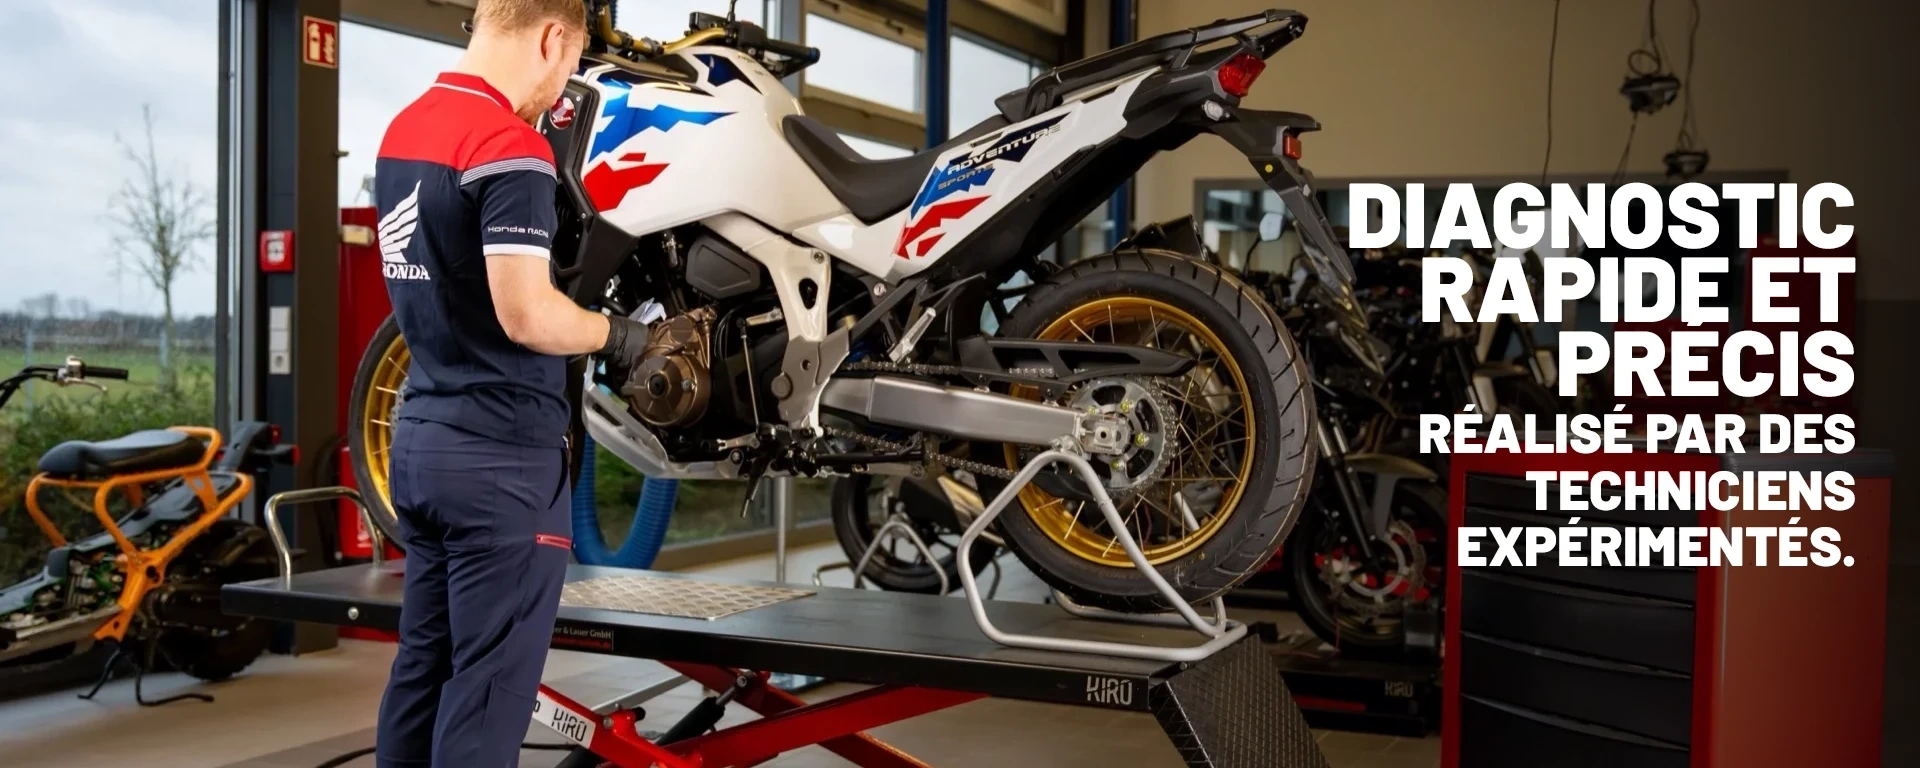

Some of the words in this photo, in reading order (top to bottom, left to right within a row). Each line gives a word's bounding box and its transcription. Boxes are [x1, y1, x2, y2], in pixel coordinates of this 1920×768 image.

[947, 124, 1061, 175] ADVENTURE
[938, 163, 994, 190] SPORTS
[487, 225, 526, 234] Honda
[590, 629, 612, 640] GmbH
[1086, 674, 1133, 706] KIRO
[551, 707, 588, 742] KIRO
